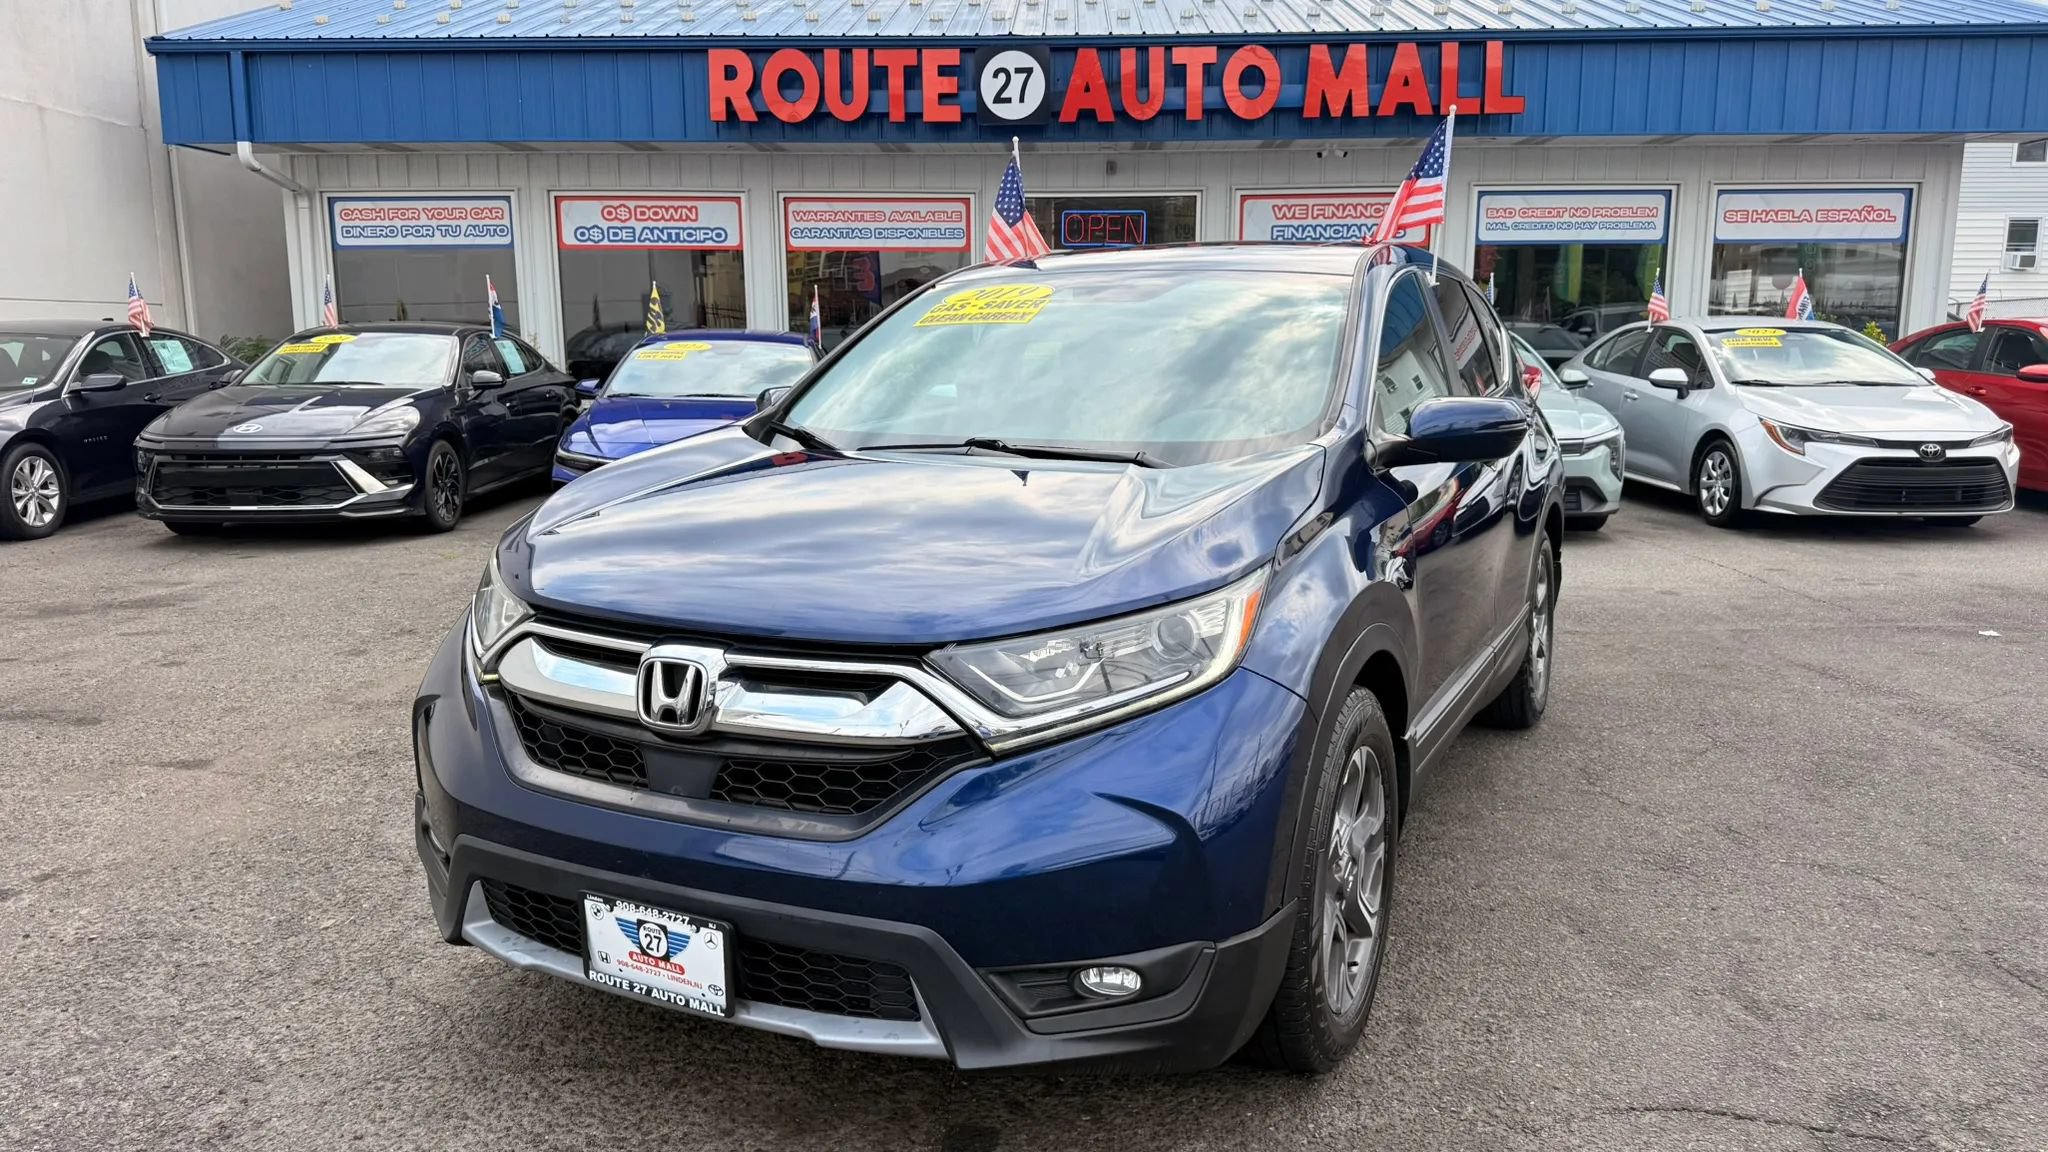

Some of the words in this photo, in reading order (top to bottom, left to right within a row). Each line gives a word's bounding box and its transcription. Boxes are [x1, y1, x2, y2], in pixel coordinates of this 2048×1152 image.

[708, 48, 961, 123] ROUTE
[991, 66, 1035, 105] 27
[1058, 45, 1282, 123] AUTO
[1302, 40, 1526, 119] MALL
[340, 208, 384, 221] CASH
[388, 208, 420, 221] FOR
[422, 207, 467, 220] YOUR
[470, 206, 504, 220] CAR
[635, 205, 698, 222] DOWN
[792, 210, 885, 223] WARRANTIES
[888, 210, 962, 223] AVAILABLE
[1272, 204, 1308, 220] WE
[1486, 208, 1516, 219] BAD
[1518, 207, 1568, 219] CREDIT
[1569, 207, 1590, 218] NO
[1592, 206, 1658, 218] PROBLEM
[1723, 210, 1750, 223] SE
[1750, 209, 1814, 223] HABLA
[1815, 205, 1897, 223] ESPAÑOL
[341, 225, 399, 239] DINERO
[401, 225, 434, 238] POR
[437, 225, 461, 238] TU
[464, 224, 510, 238] AUTO
[791, 227, 872, 240] GARANTIAS
[874, 227, 965, 240] DISPONIBLES
[1065, 214, 1144, 243] OPEN
[1486, 222, 1510, 231] MAL
[1511, 222, 1556, 231] CREDITO
[1557, 222, 1573, 231] NO
[1574, 221, 1598, 230] HAY
[1599, 221, 1656, 230] PROBLEMA
[607, 226, 636, 243] DE
[638, 227, 728, 244] ANTICIPO
[930, 301, 971, 314] GAS
[979, 299, 1046, 310] SAVER
[919, 312, 969, 325] CLEAN
[968, 311, 1031, 322] CARFAX
[615, 900, 691, 925] 908-648-2727
[643, 925, 662, 935] ROUTE
[644, 933, 663, 953] 27
[632, 953, 655, 966] AUTO
[658, 961, 682, 973] MALL
[589, 970, 630, 990] ROUTE
[633, 983, 648, 995] 27
[651, 988, 686, 1006] AUTO
[689, 997, 725, 1016] MALL
